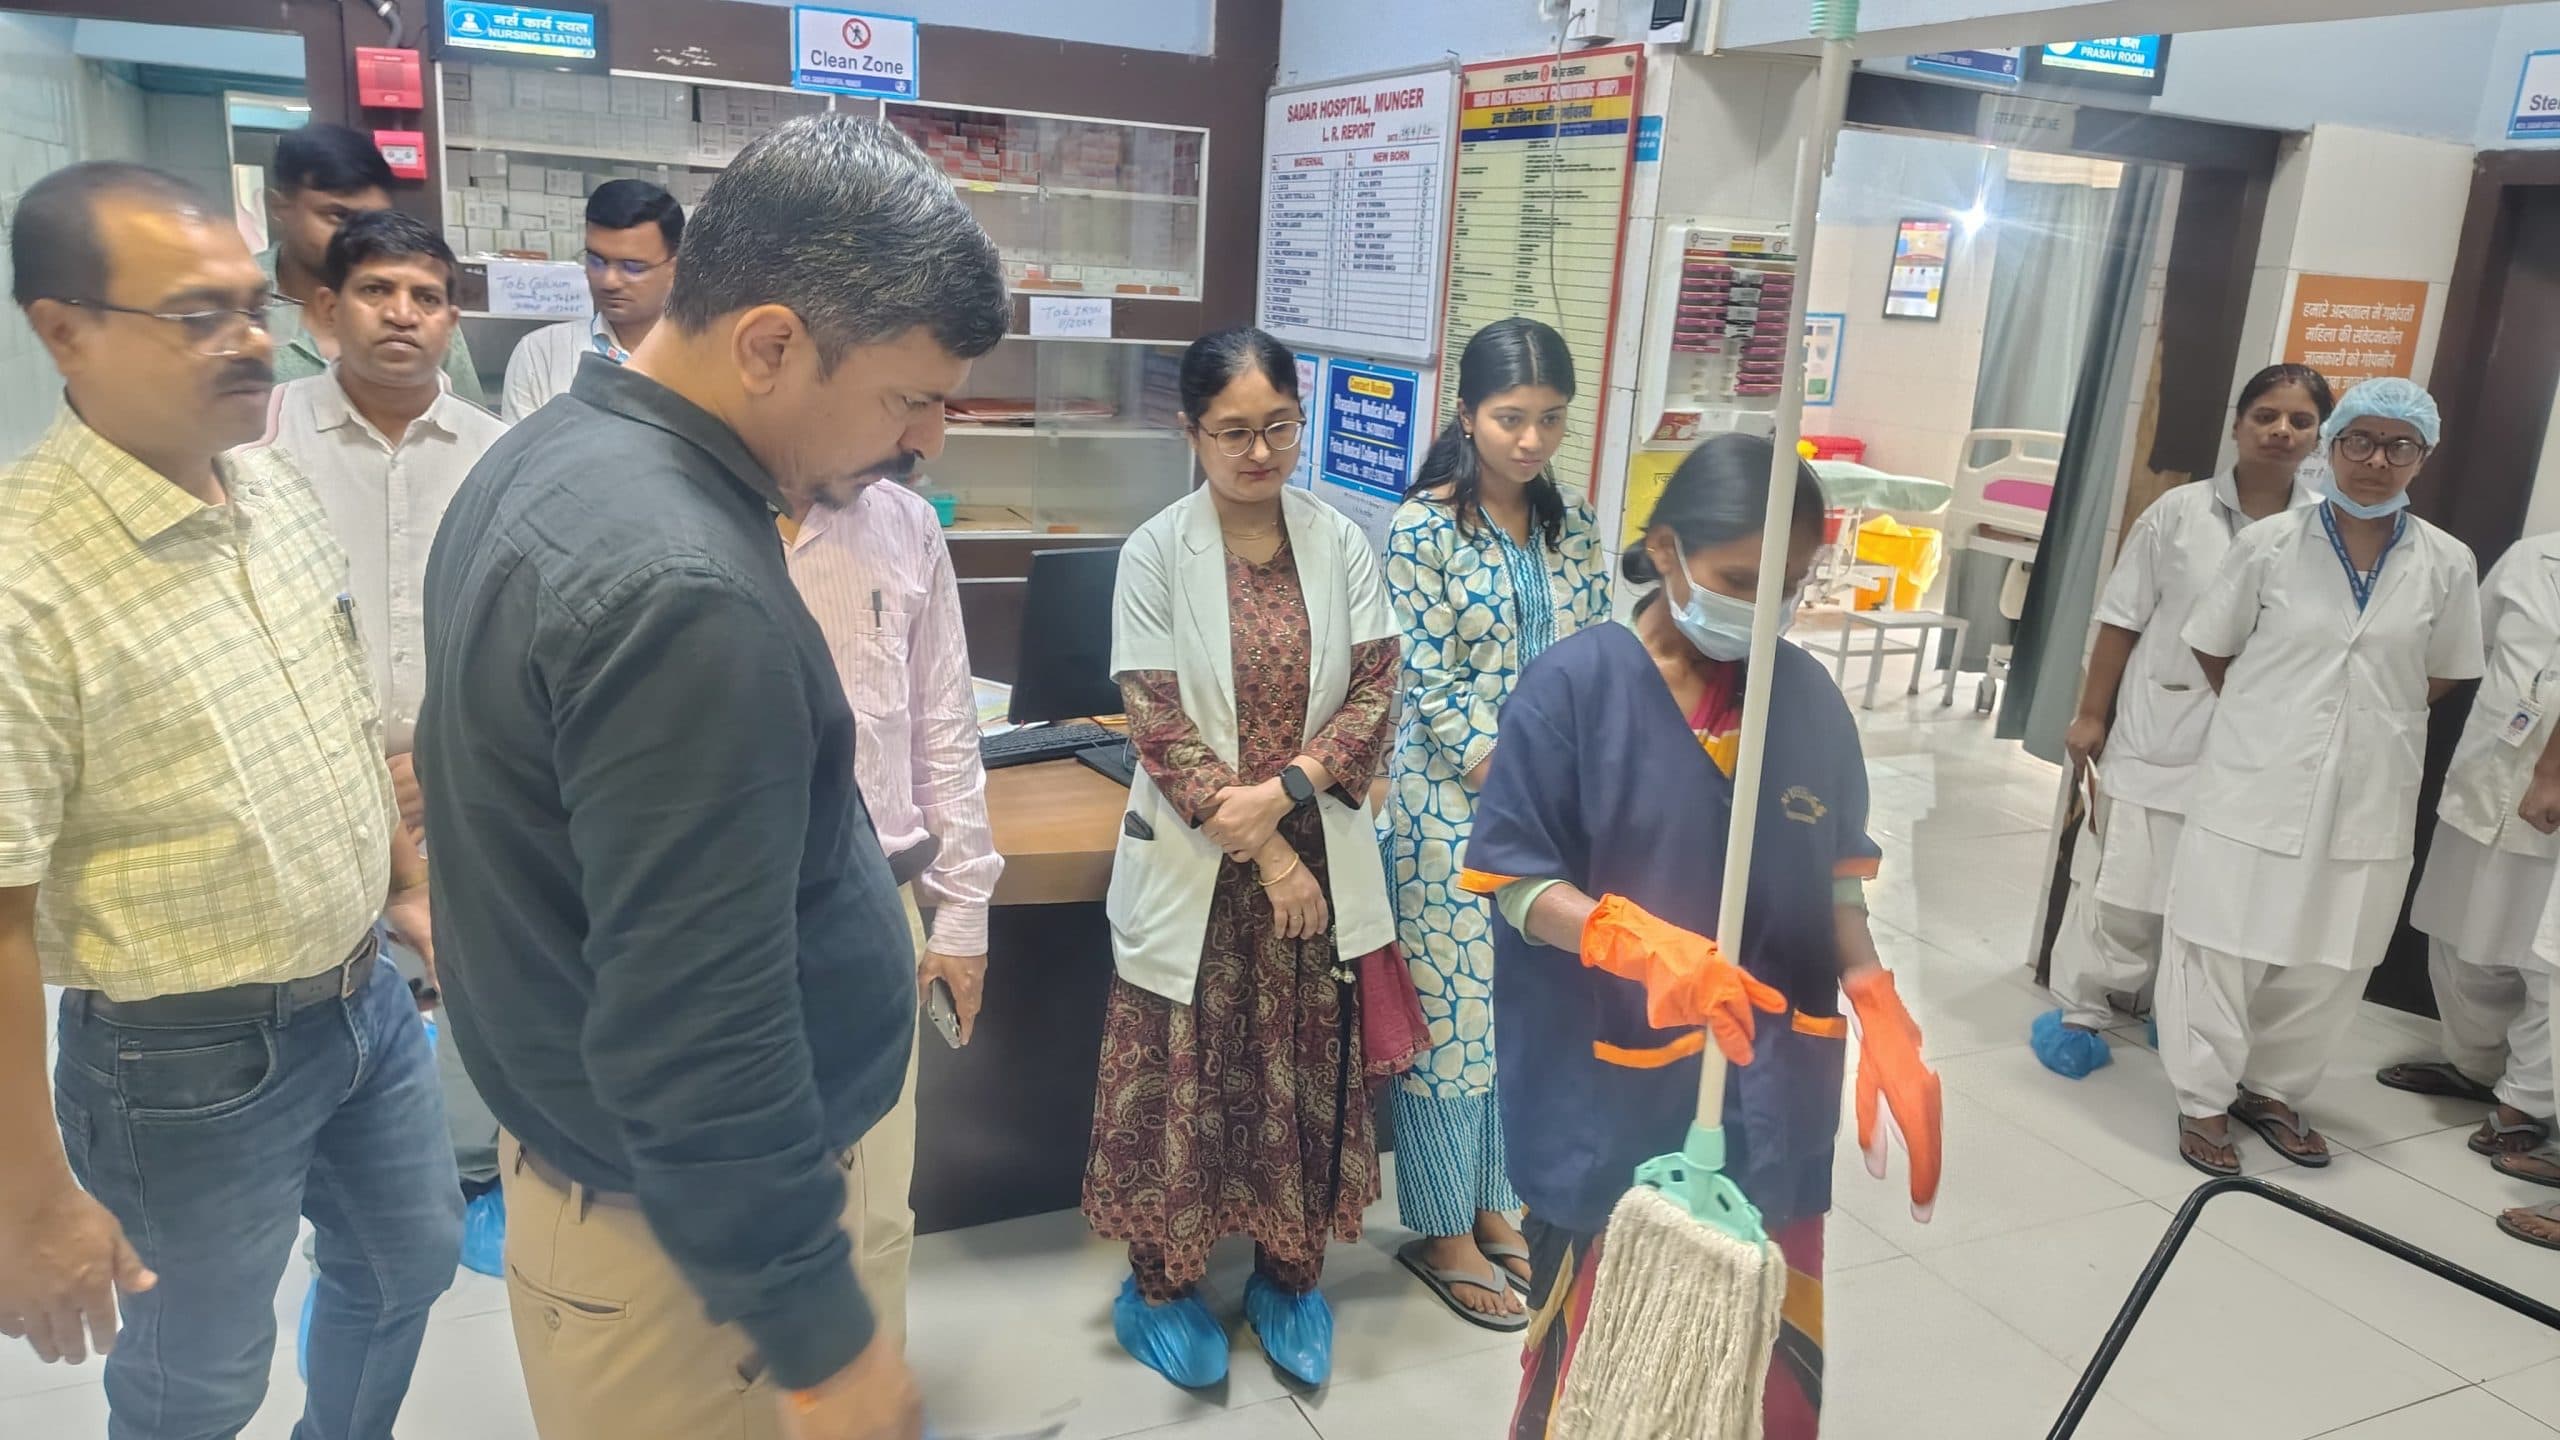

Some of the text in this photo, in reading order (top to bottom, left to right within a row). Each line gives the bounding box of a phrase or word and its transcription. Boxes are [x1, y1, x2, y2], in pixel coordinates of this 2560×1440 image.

[487, 27, 592, 47] NURSING STATION
[810, 49, 904, 75] Clean Zone
[2080, 46, 2146, 65] PRASAV ROOM
[1287, 87, 1424, 123] SADAR HOSPITAL, MUNGER
[1341, 122, 1376, 141] REPORT
[1372, 150, 1410, 163] NEW BORN
[496, 275, 526, 290] Tab
[1040, 304, 1070, 320] Tab
[2303, 299, 2329, 318] हमारे
[2330, 303, 2371, 320] अस्पताल
[2305, 323, 2337, 342] महिला
[2338, 324, 2353, 343] की
[2303, 348, 2396, 368] जानकारी को गोपनीय
[1361, 398, 1384, 419] Medical
[1384, 403, 1407, 427] College
[1343, 439, 1361, 459] Medical
[1361, 444, 1378, 467] College
[1384, 449, 1405, 472] Hospital
